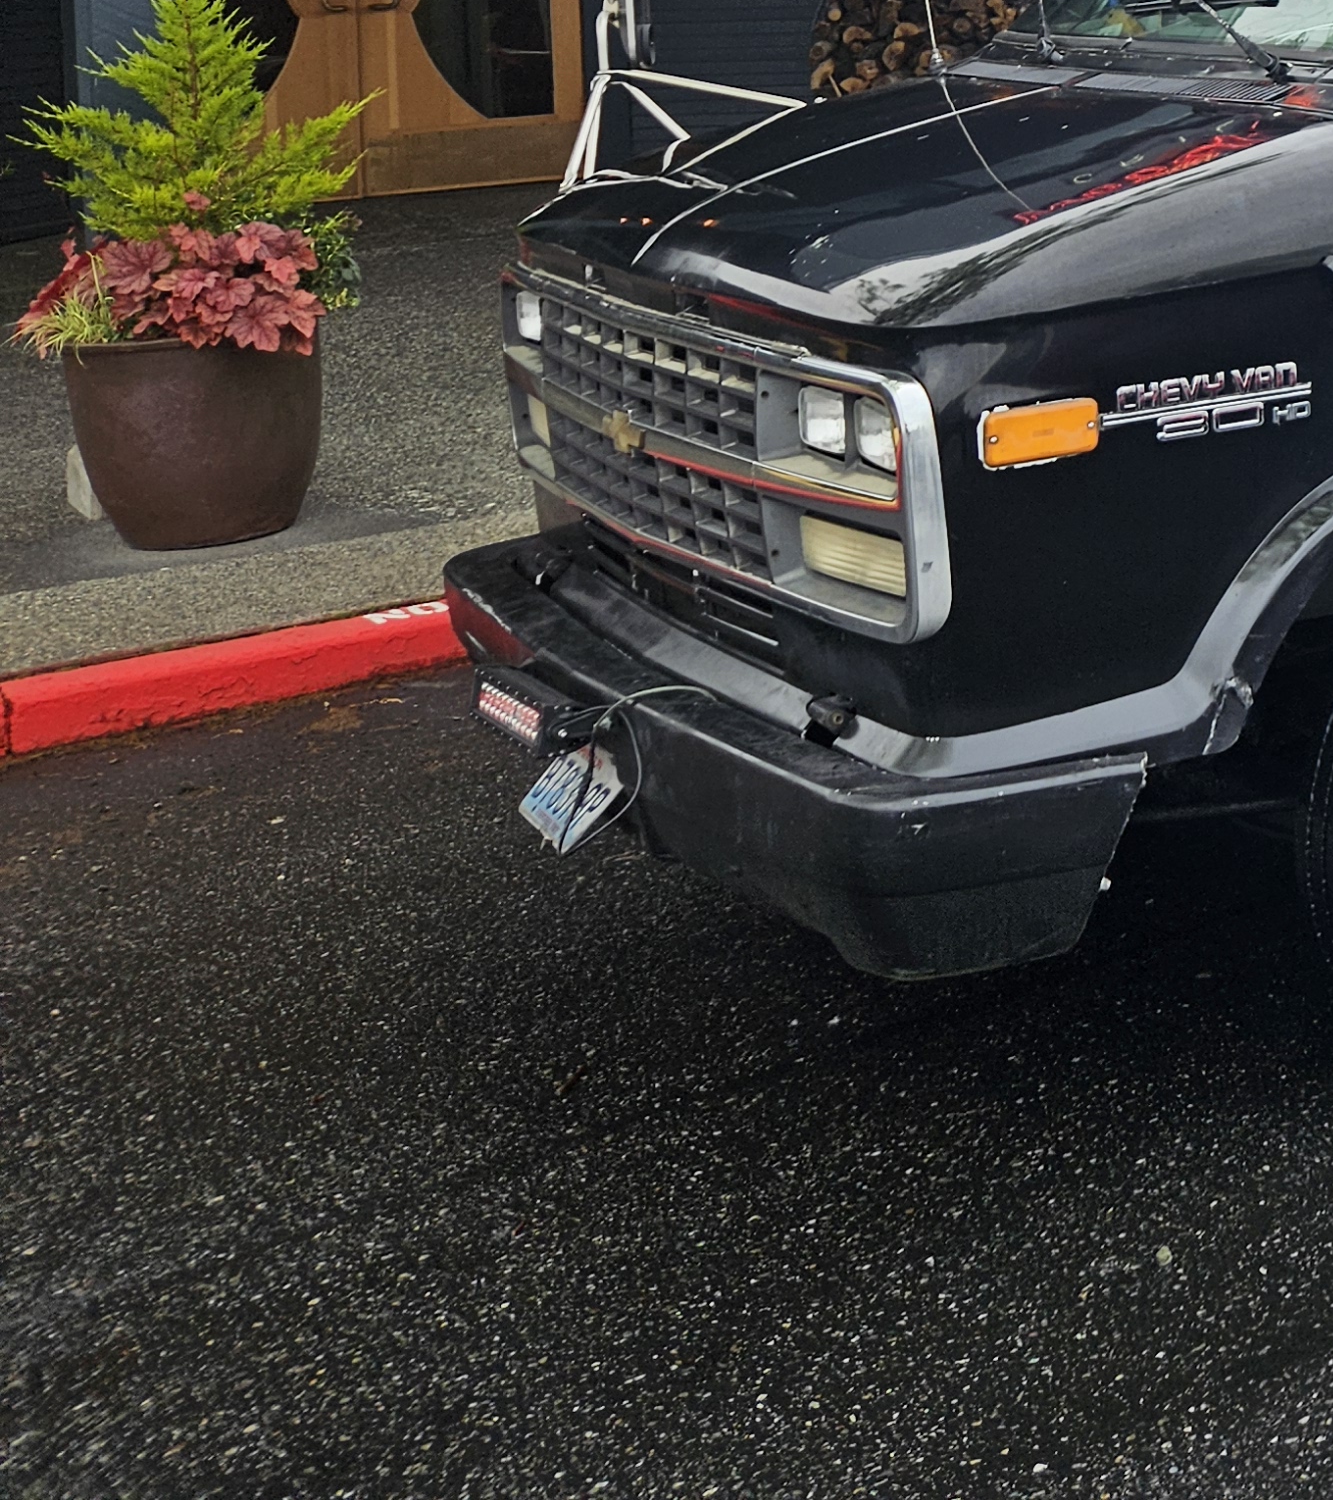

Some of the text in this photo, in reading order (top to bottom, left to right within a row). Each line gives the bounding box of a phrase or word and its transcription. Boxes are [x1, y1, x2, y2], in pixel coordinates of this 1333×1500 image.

[1115, 361, 1298, 412] CHEVY VAN
[1156, 400, 1312, 442] 30 HD
[362, 601, 450, 625] NO
